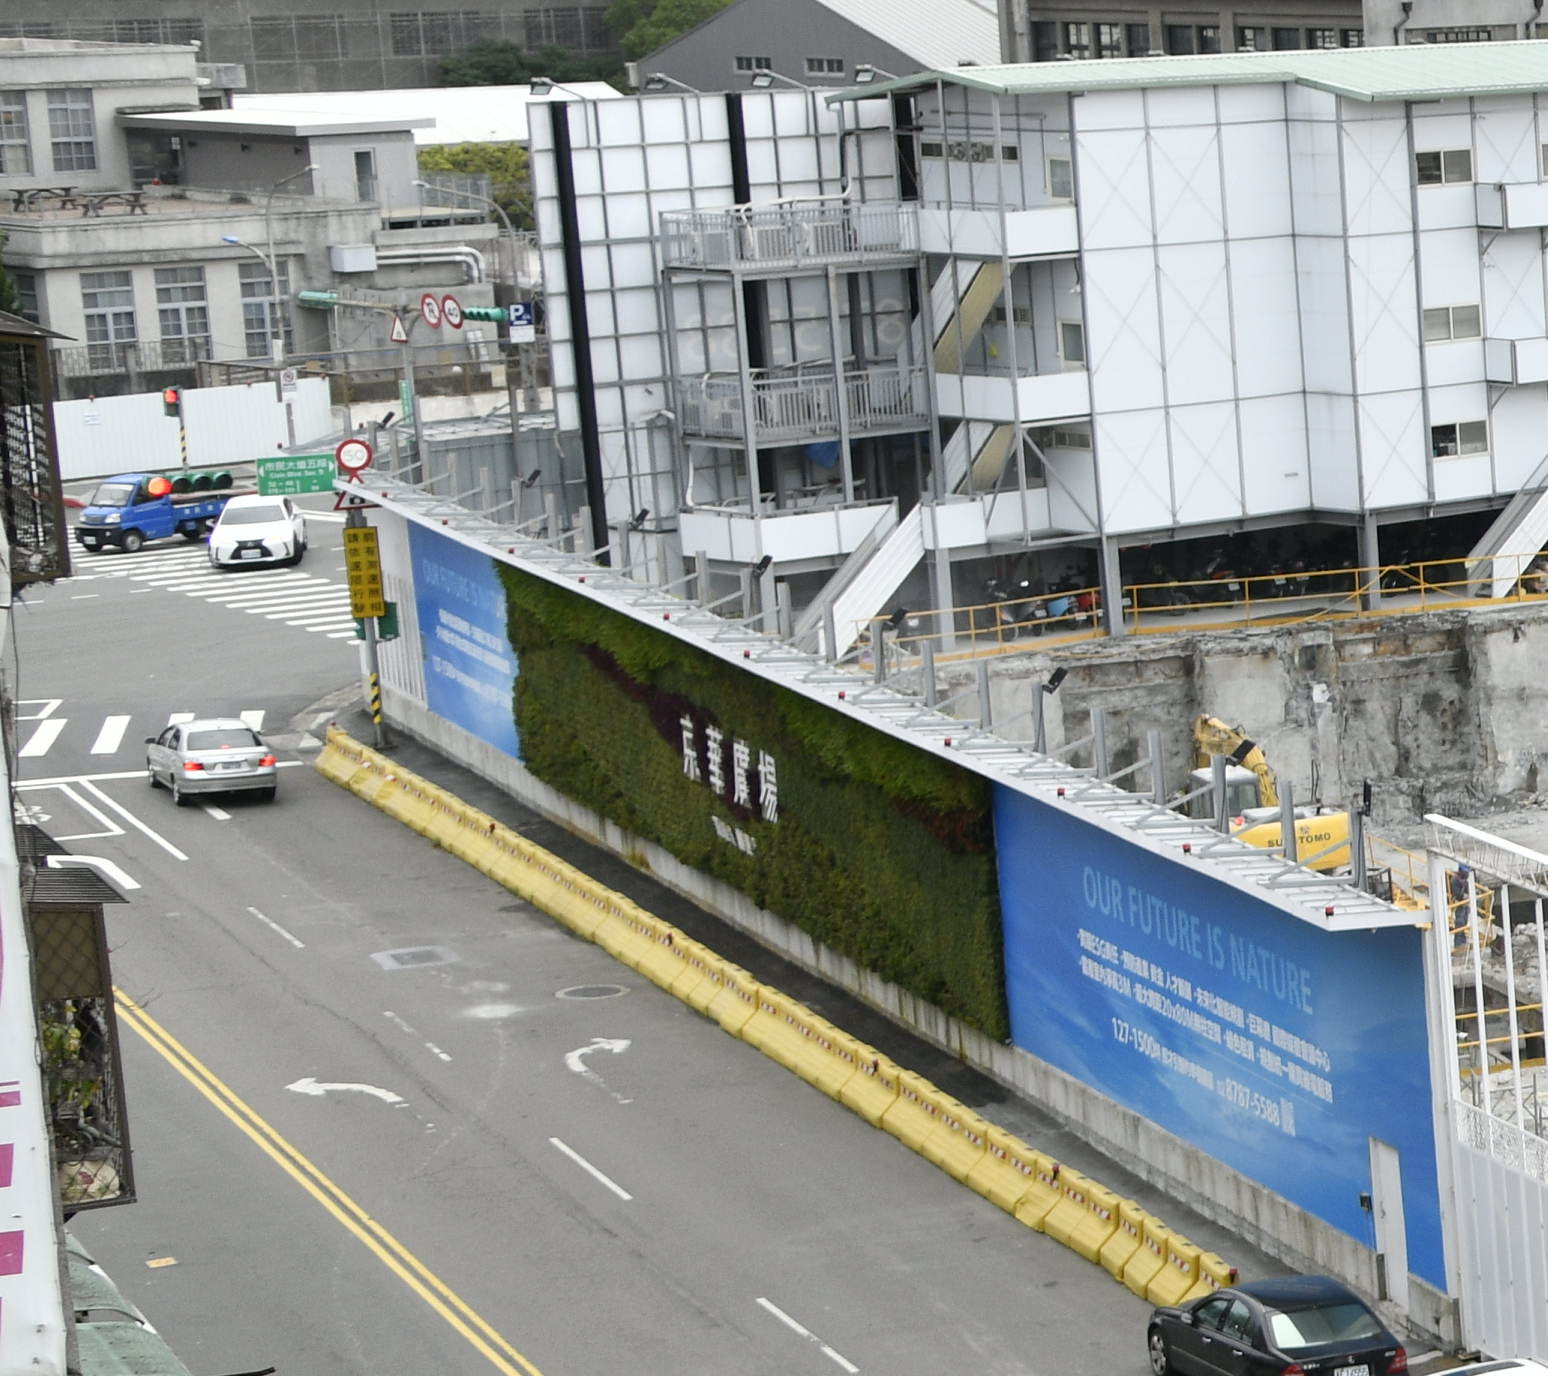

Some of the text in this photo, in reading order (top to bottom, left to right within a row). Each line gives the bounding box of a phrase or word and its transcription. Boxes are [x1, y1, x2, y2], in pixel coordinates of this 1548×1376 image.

[510, 304, 524, 321] P
[1083, 866, 1125, 923] OUR
[1127, 886, 1202, 961] FUTURE
[1207, 922, 1225, 970] IS
[1230, 933, 1313, 1016] NATURE
